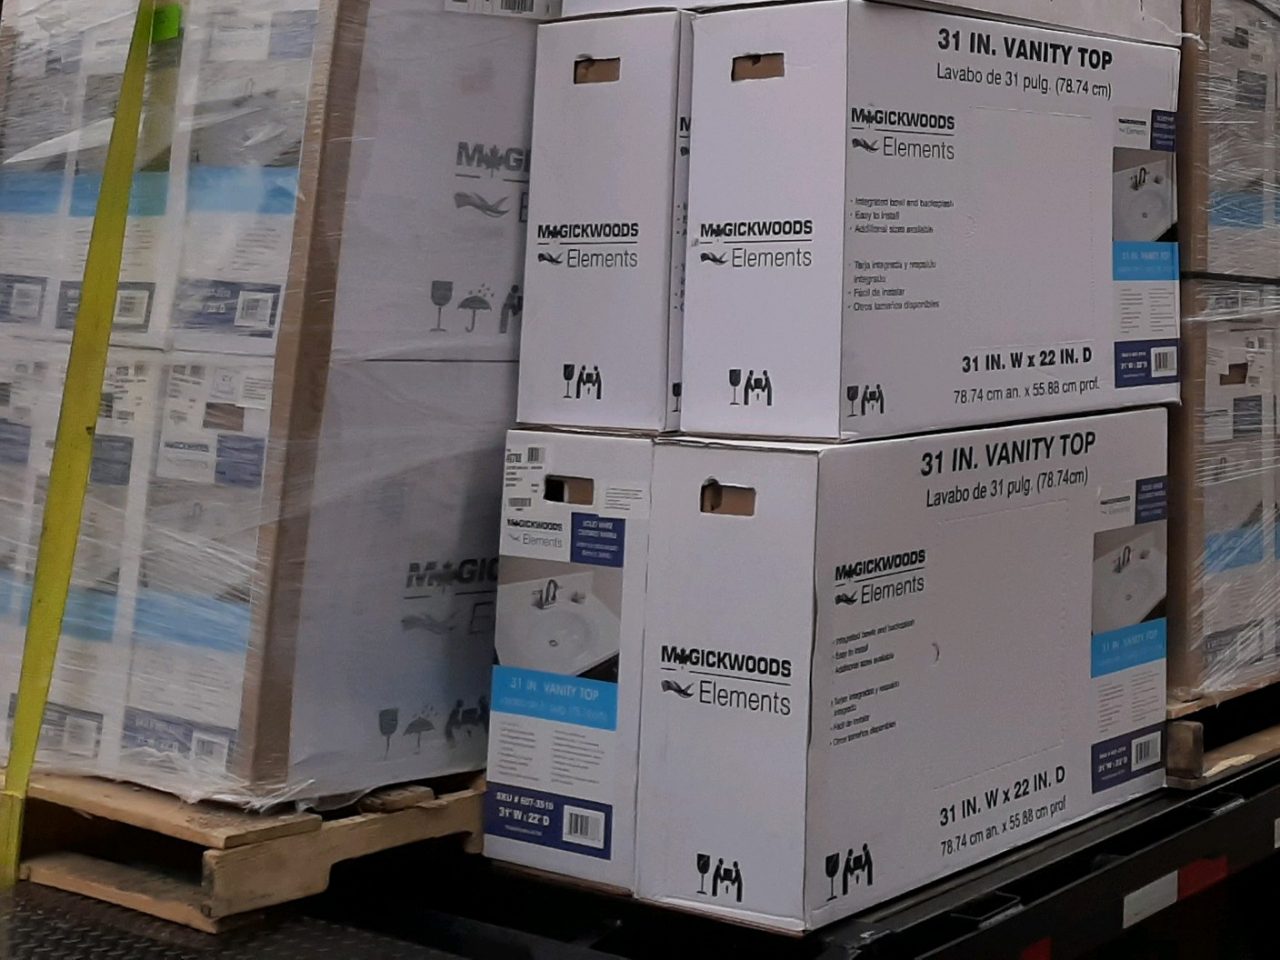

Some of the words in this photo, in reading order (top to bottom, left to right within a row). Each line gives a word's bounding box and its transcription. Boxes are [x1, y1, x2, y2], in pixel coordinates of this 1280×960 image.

[938, 28, 960, 51] 31
[969, 32, 996, 56] IN.
[1004, 37, 1073, 65] VANITY
[1078, 48, 1113, 70] TOP
[937, 62, 983, 83] Lavabo
[986, 69, 1001, 86] de
[1005, 71, 1019, 87] 31
[1023, 74, 1051, 95] pulg.
[1055, 77, 1089, 97] (78.74
[1092, 82, 1112, 100] cm)
[883, 136, 955, 160] Elements
[567, 248, 638, 268] Elements
[732, 247, 812, 268] Elements
[961, 354, 979, 373] 31
[985, 352, 1005, 371] IN.
[1010, 351, 1024, 369] W
[1027, 354, 1036, 368] x
[1039, 350, 1056, 367] 22
[1060, 348, 1079, 365] IN.
[1082, 346, 1092, 363] D
[953, 388, 984, 405] 78.74
[986, 388, 1002, 401] cm
[1005, 387, 1021, 400] an.
[1024, 387, 1031, 397] x
[1033, 381, 1060, 397] 55.88
[1062, 381, 1077, 395] cm
[921, 450, 943, 476] 31
[952, 446, 978, 472] IN.
[985, 436, 1055, 467] VANITY
[1060, 431, 1096, 456] TOP
[926, 484, 969, 507] Lavabo
[972, 481, 987, 500] de
[990, 479, 1004, 497] 31
[1007, 475, 1033, 498] pulg.
[523, 533, 562, 548] Elements
[861, 576, 924, 604] Elements
[510, 676, 522, 689] 31
[543, 681, 577, 699] VANITY
[579, 686, 600, 702] TOP
[700, 680, 791, 715] Elements
[939, 804, 956, 827] 31
[962, 798, 981, 819] IN.
[985, 788, 1000, 809] W
[1002, 789, 1011, 805] x
[1014, 779, 1030, 798] 22
[1034, 771, 1051, 792] IN.
[1055, 765, 1066, 784] D
[542, 814, 550, 827] D
[941, 835, 967, 857] 78.74
[969, 830, 984, 846] cm
[985, 825, 1000, 841] an.
[1001, 822, 1008, 834] x
[1009, 808, 1034, 831] 55.88
[1035, 805, 1049, 822] cm
